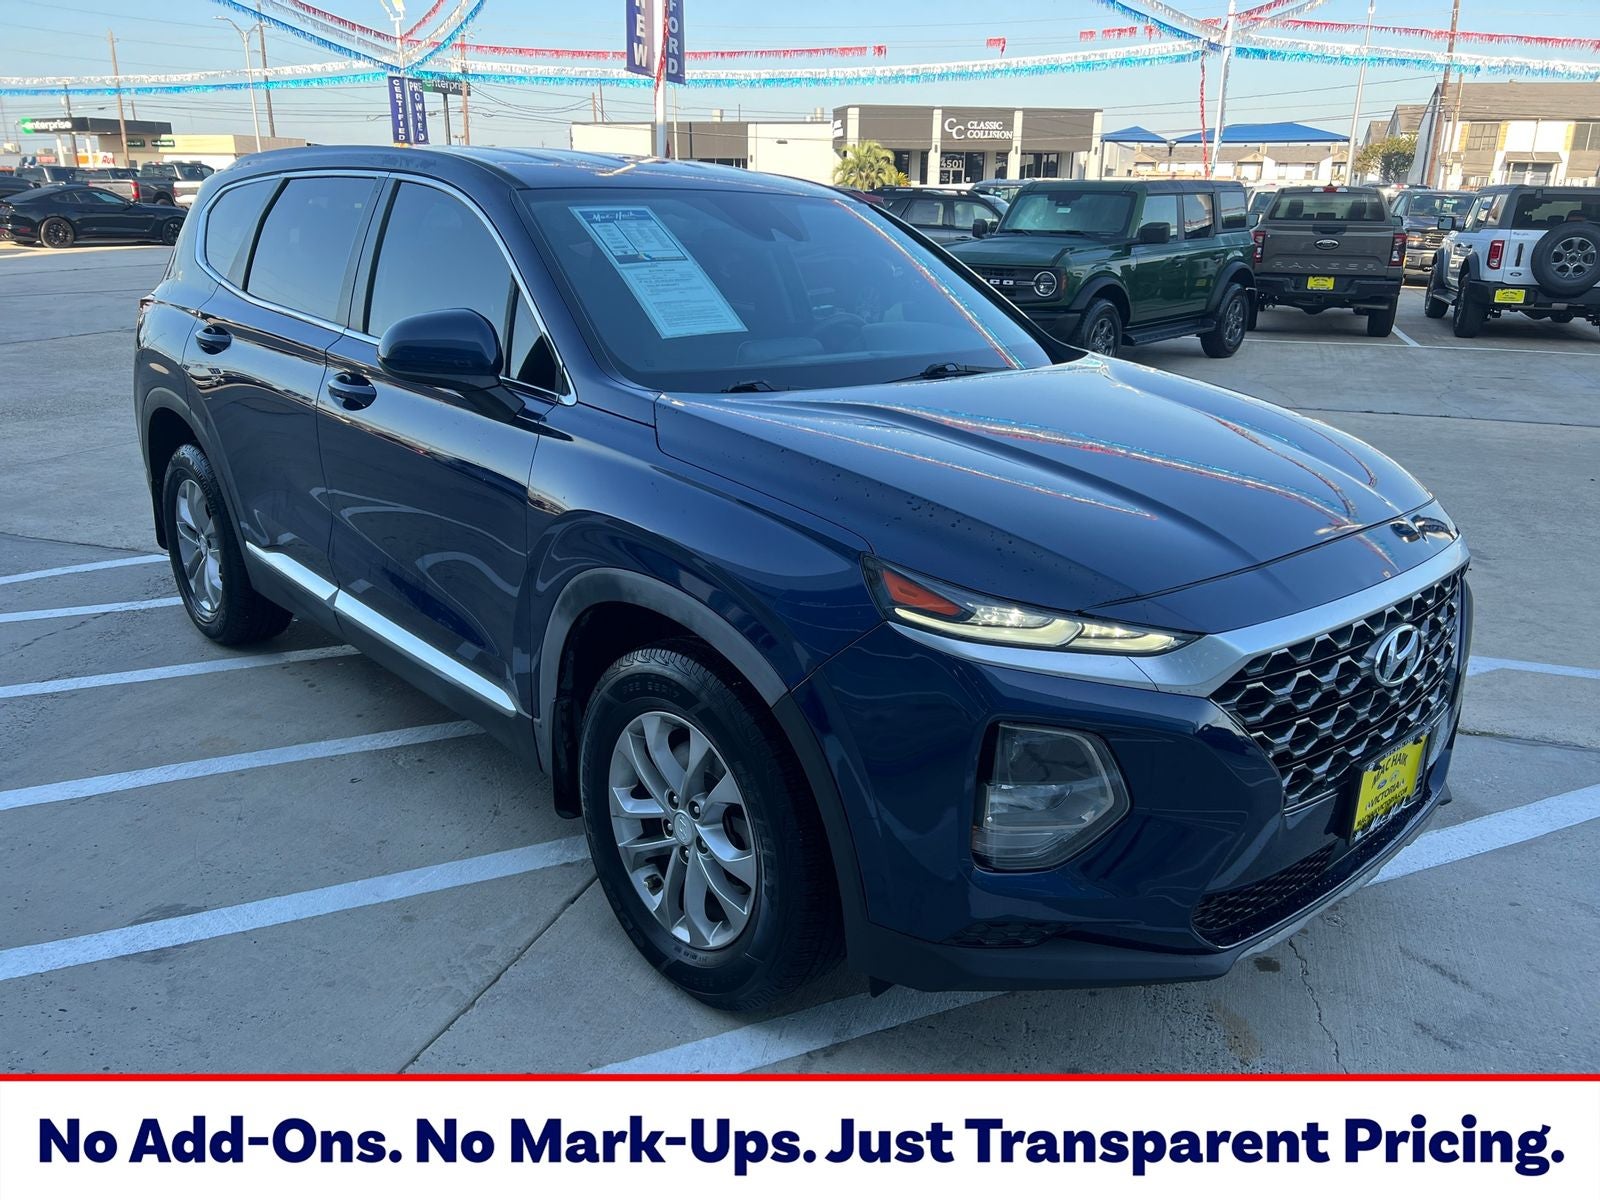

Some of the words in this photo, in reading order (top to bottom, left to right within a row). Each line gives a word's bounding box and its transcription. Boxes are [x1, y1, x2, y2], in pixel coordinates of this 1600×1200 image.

[668, 0, 679, 74] FORD
[408, 81, 423, 92] PRE
[392, 79, 406, 141] CERTIFIED
[414, 92, 425, 142] OWNED
[22, 119, 72, 131] enterprise
[967, 120, 1003, 130] CLASSIC
[967, 130, 1014, 140] COLLISION
[940, 159, 963, 168] 4501
